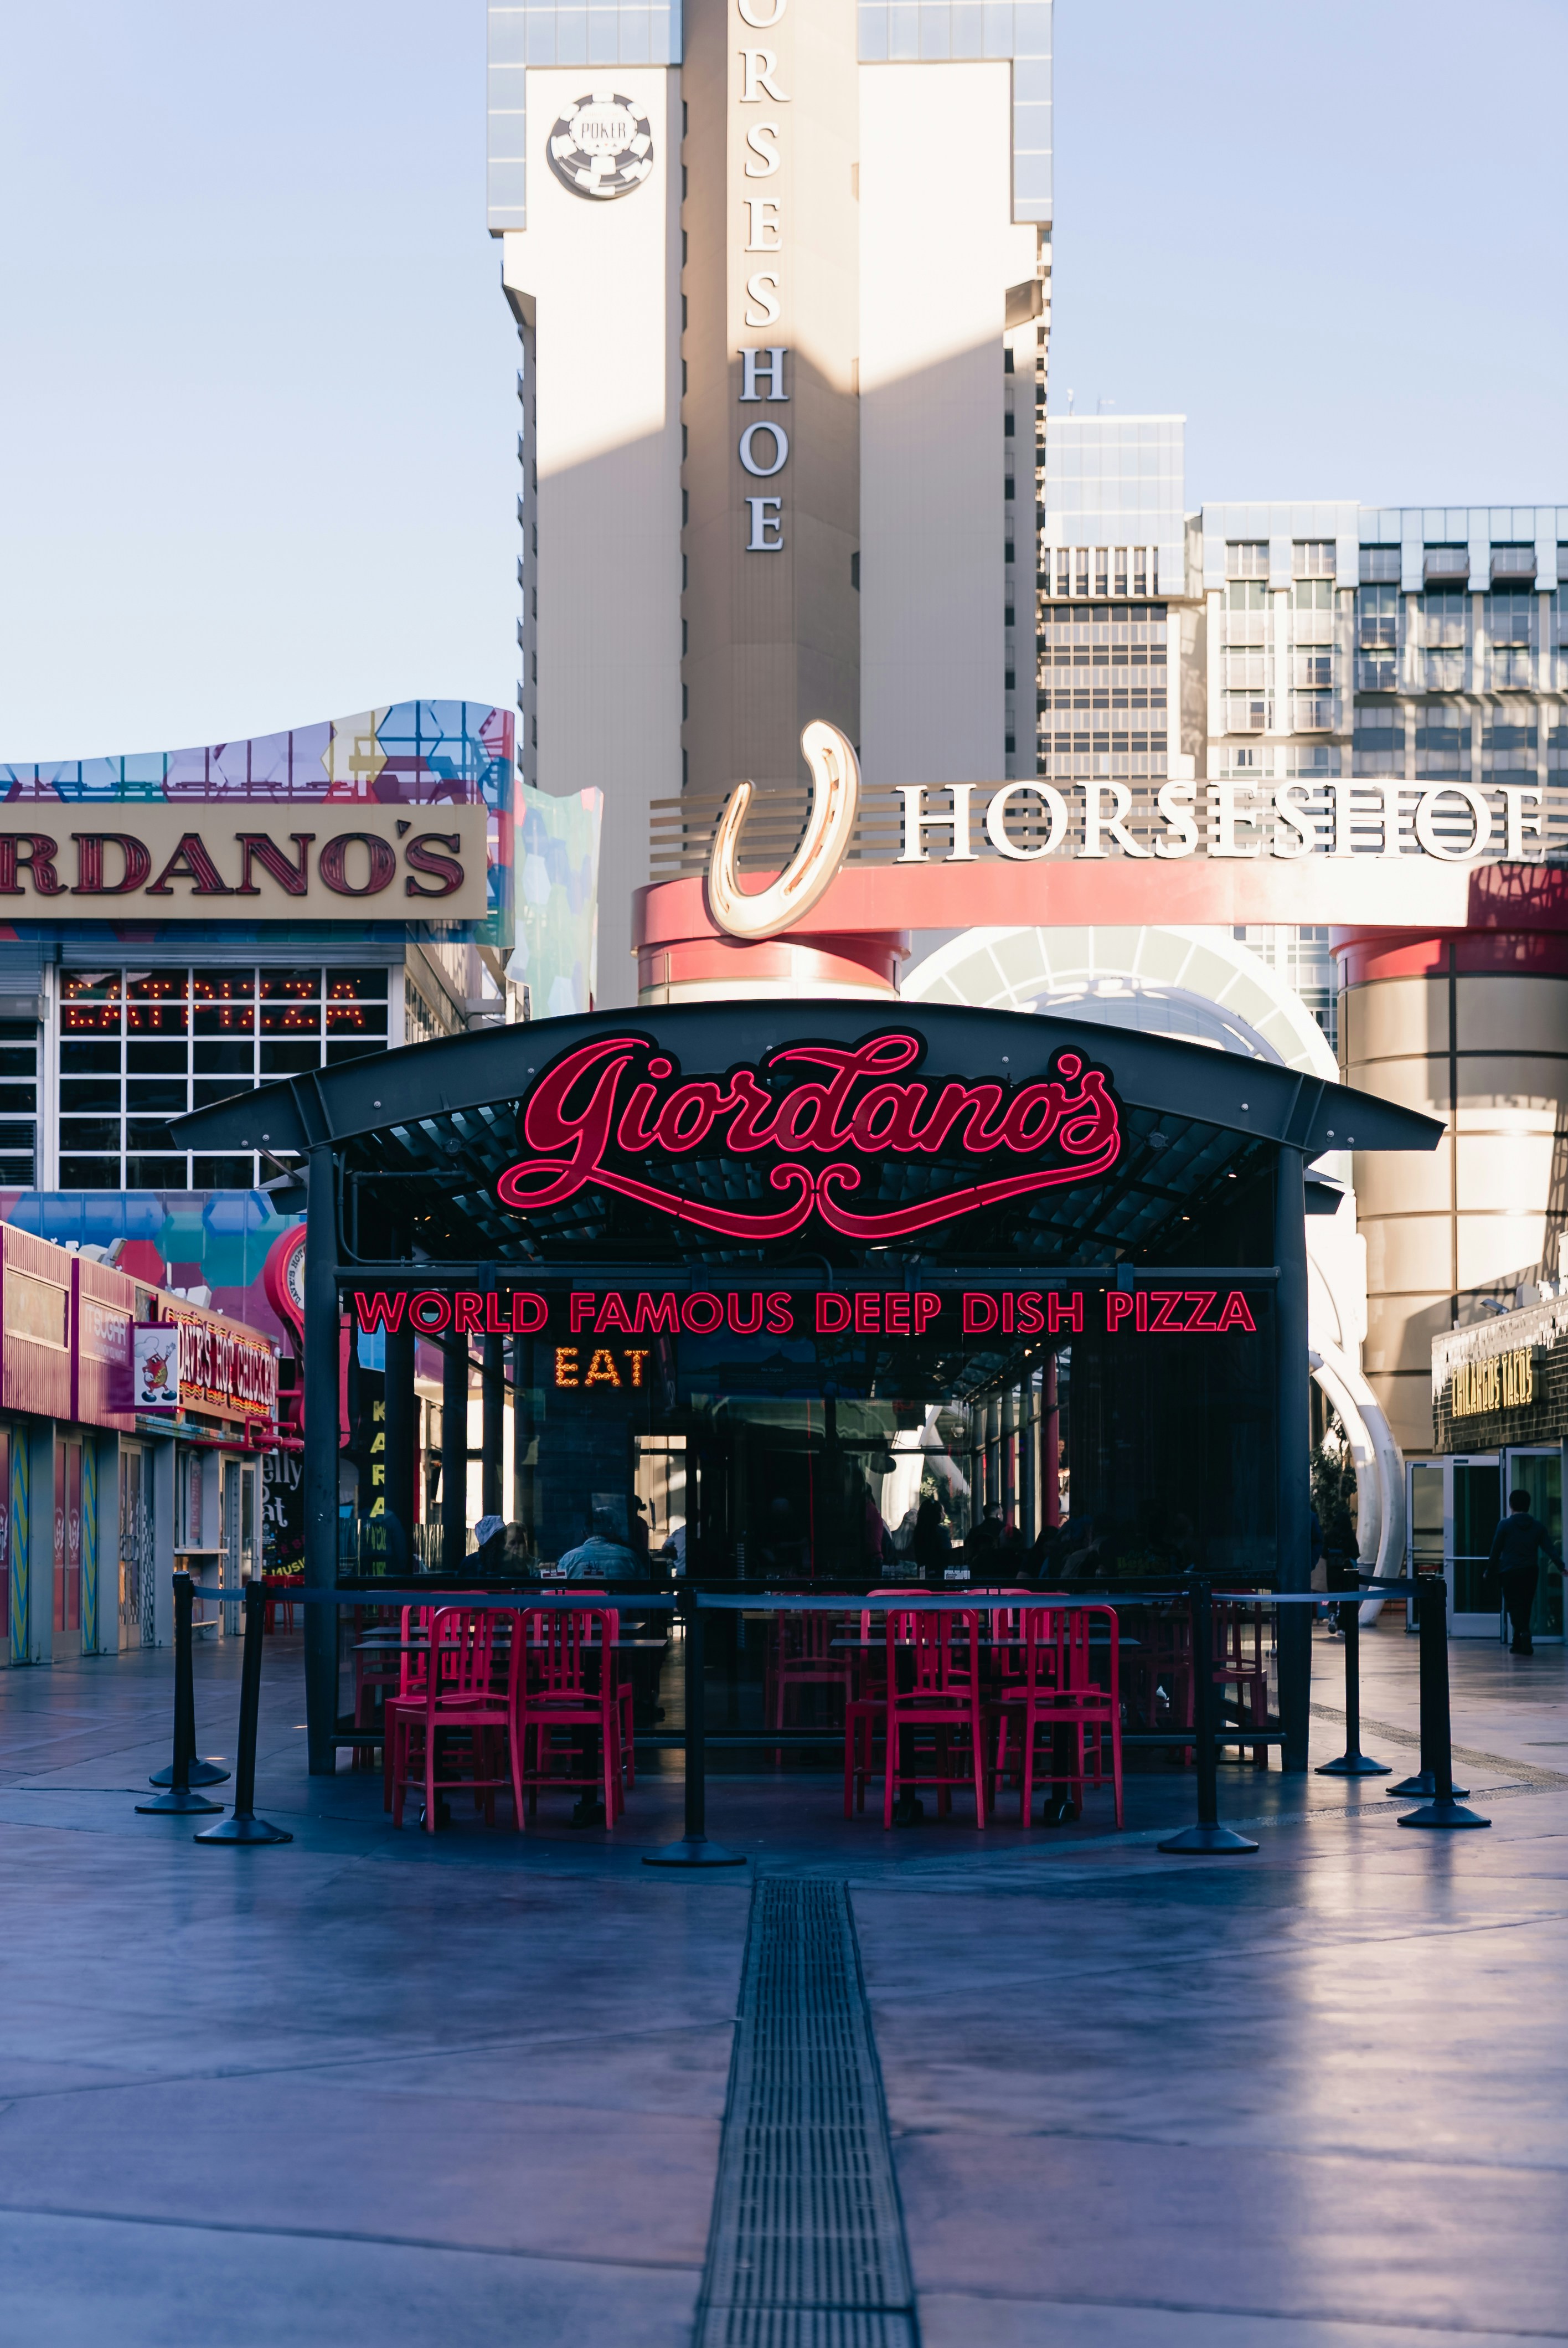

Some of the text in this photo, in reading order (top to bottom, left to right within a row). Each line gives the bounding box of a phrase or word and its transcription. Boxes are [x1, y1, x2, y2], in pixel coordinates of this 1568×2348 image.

[581, 122, 626, 139] POKER
[894, 777, 1546, 863] HORSESHOE
[64, 979, 367, 1028] EAT PIZZA
[497, 1034, 1120, 1239] Giordano's
[354, 1291, 1256, 1333] WORLD FAMOUS DEEP DISH PIZZA
[215, 1334, 234, 1394] HOT
[238, 1344, 276, 1405] CHICKEN
[555, 1346, 651, 1388] EAT
[1502, 1346, 1533, 1407] TACOS
